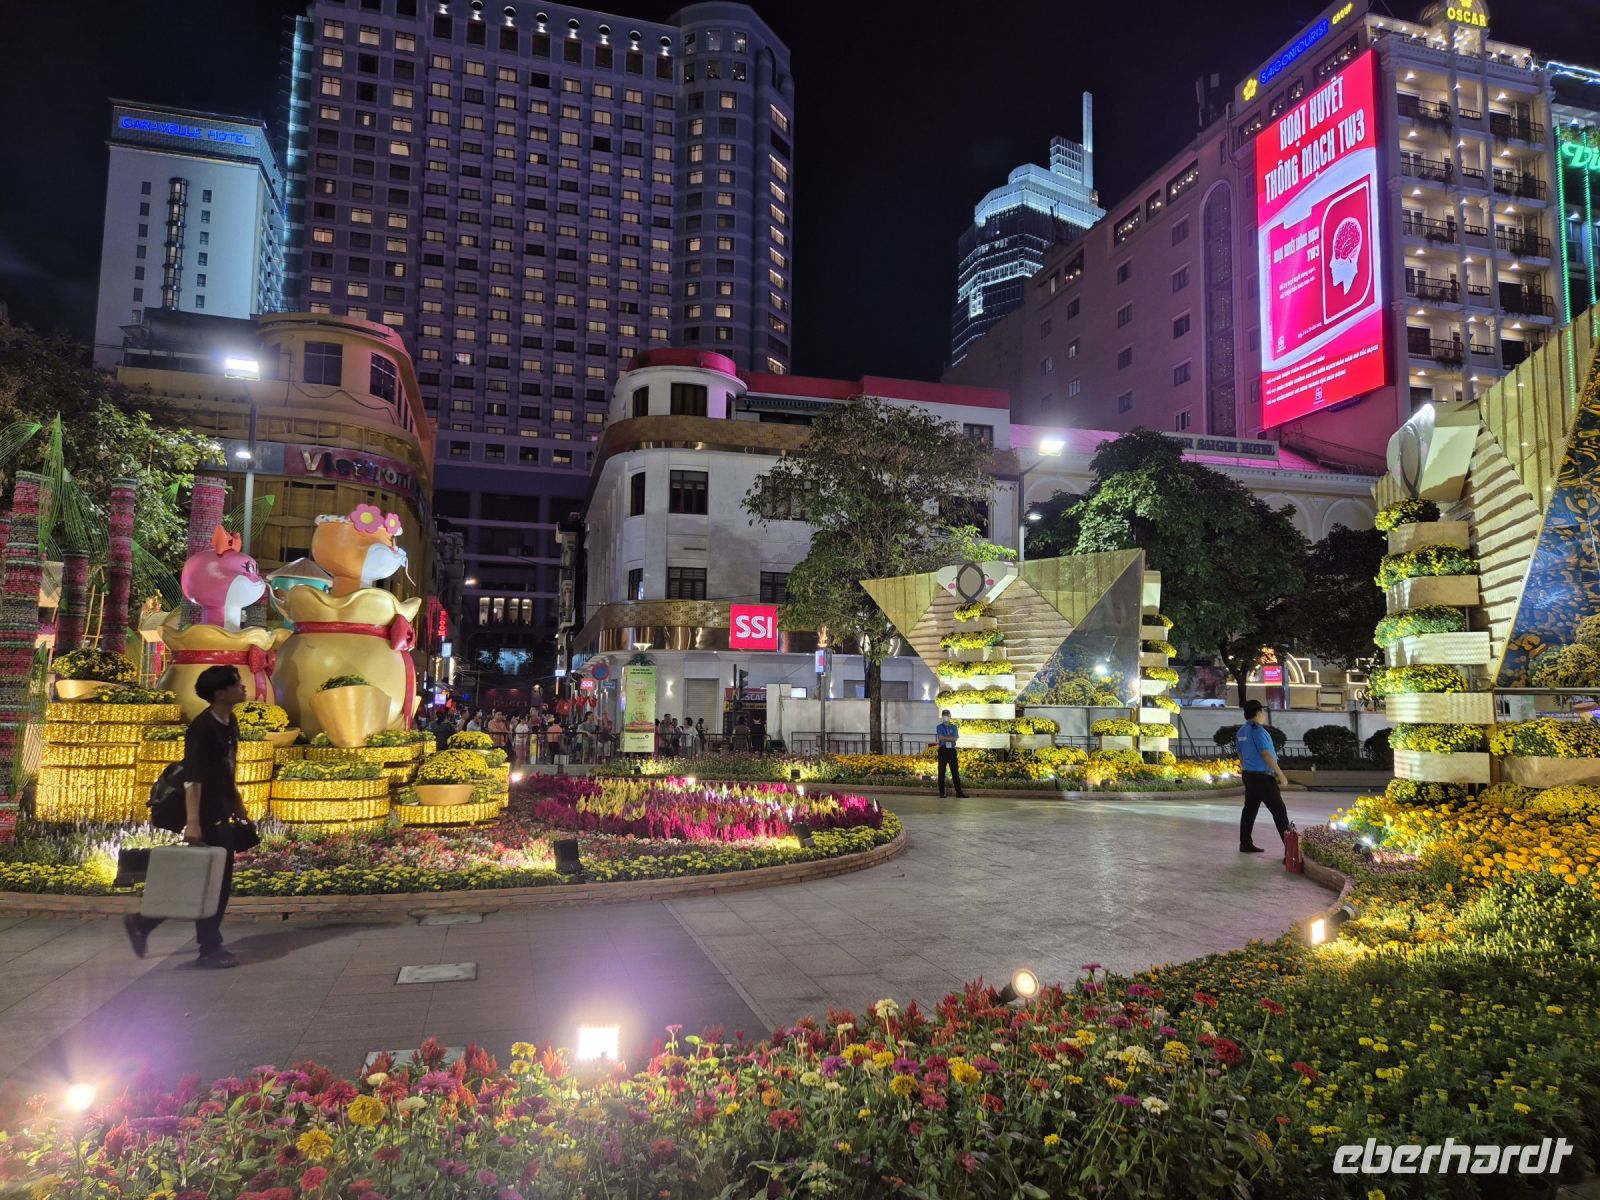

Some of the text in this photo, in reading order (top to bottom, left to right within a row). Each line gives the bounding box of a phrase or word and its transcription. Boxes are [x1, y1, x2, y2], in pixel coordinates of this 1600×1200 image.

[1332, 2, 1352, 25] GROUP
[1447, 7, 1487, 27] OSCAR
[120, 116, 253, 145] CARAVELLE HOTEL
[1264, 154, 1299, 203] THÔNG
[1337, 108, 1365, 154] TW3
[735, 615, 773, 639] SSI
